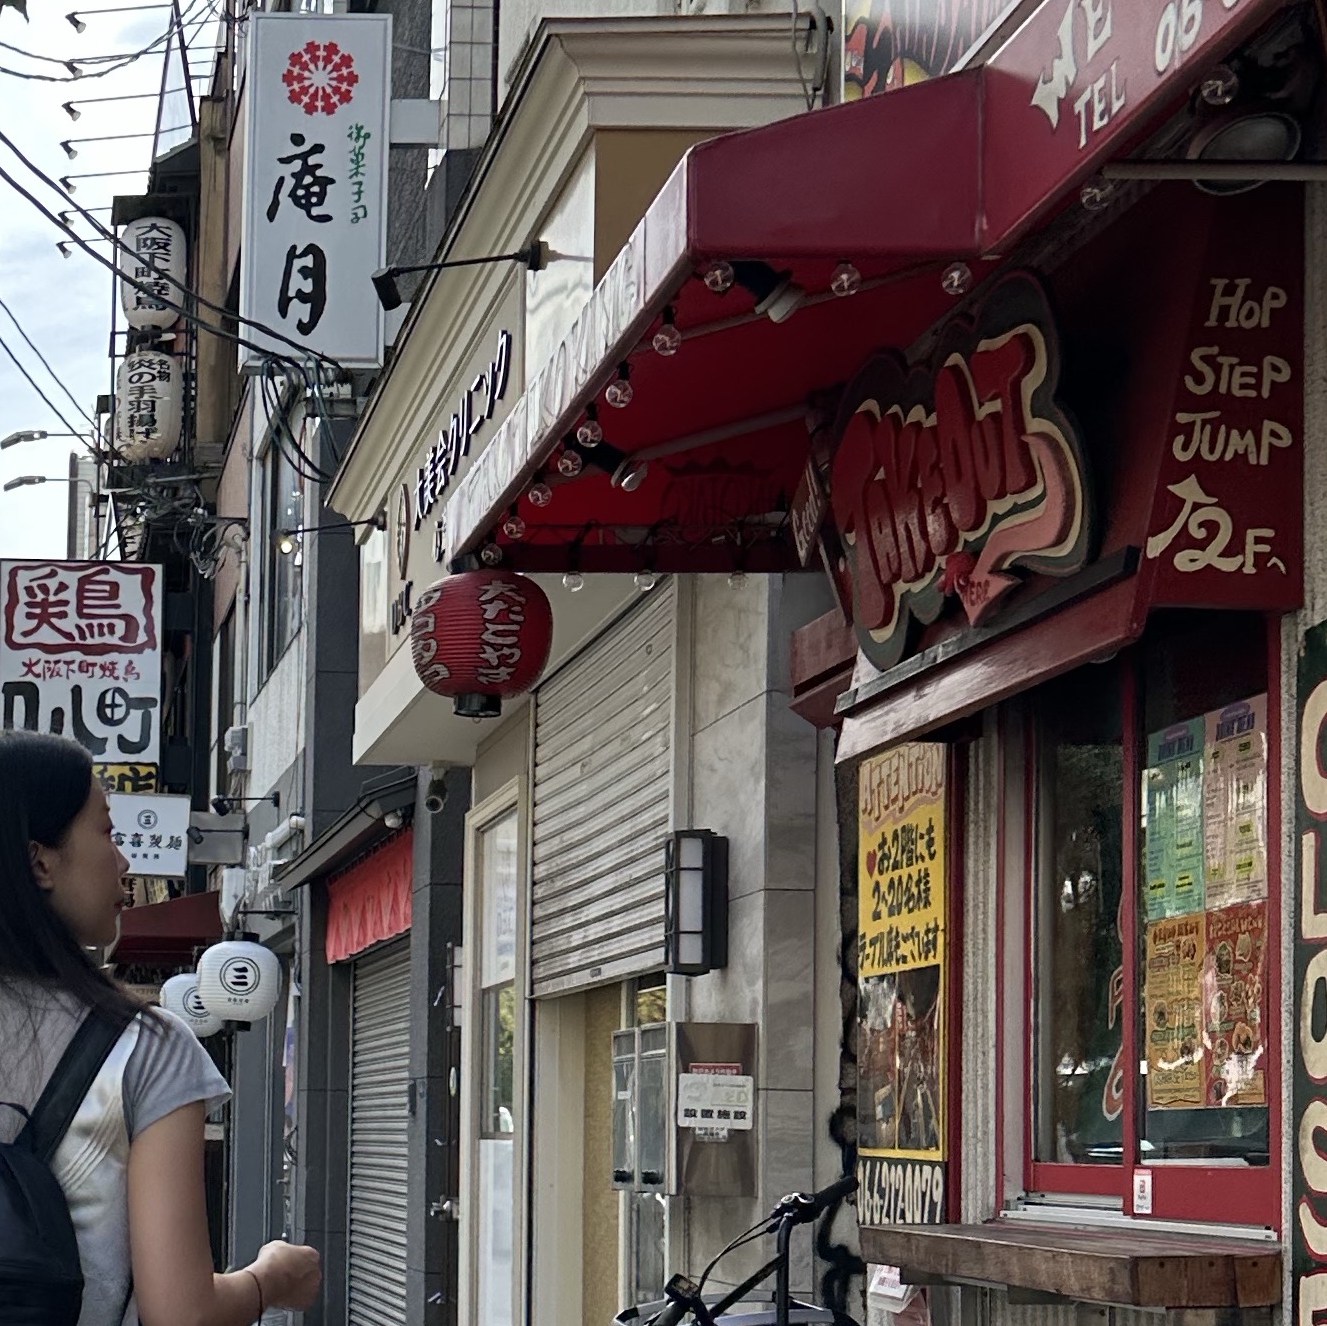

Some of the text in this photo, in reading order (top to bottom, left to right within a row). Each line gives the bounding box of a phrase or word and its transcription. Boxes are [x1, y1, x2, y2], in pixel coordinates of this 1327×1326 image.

[1074, 60, 1125, 149] TEL
[347, 123, 371, 224] 御菓子司
[266, 133, 337, 336] 庵月
[1204, 278, 1287, 328] HOP
[1185, 347, 1291, 398] STEP
[1172, 413, 1293, 465] JUMP
[21, 658, 141, 682] 大阪下町焼鳥
[859, 744, 945, 821] ATTENTION
[877, 817, 937, 876] お2階にも
